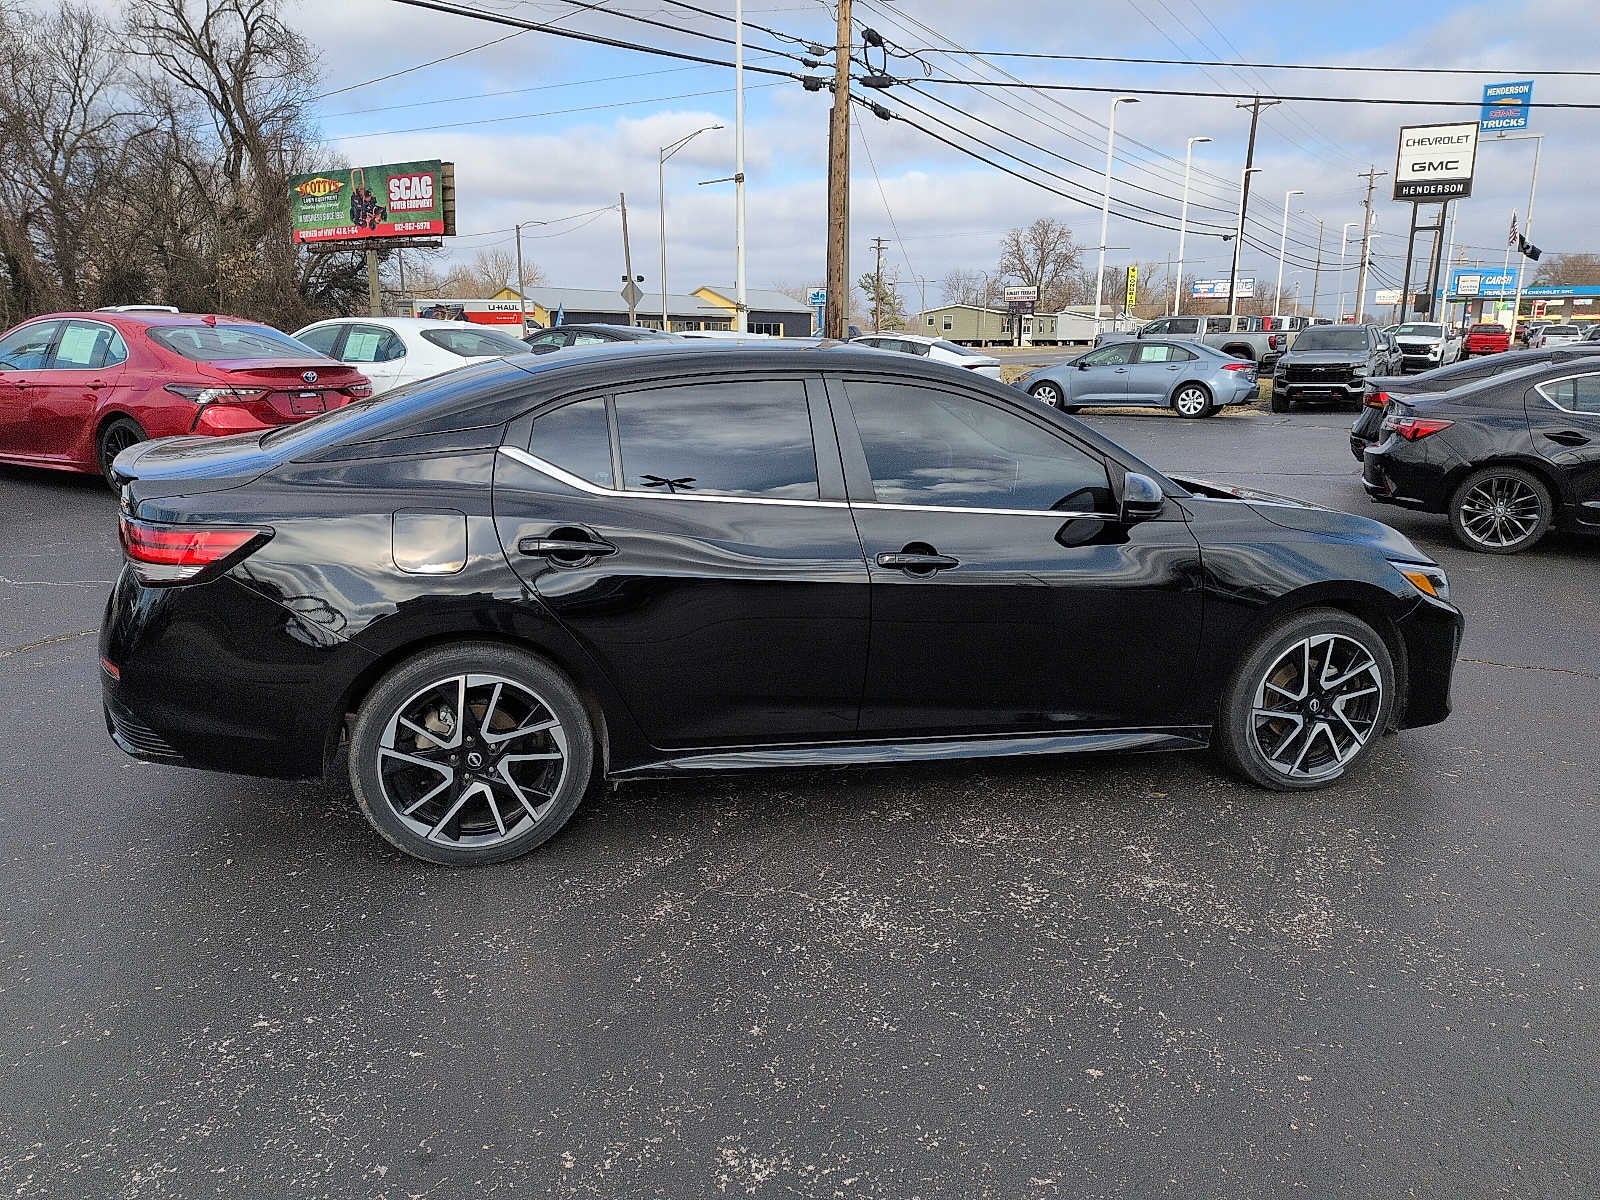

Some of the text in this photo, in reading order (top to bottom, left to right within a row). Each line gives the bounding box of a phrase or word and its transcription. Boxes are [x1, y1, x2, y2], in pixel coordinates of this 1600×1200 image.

[1487, 85, 1529, 96] HENDERSON
[1482, 117, 1525, 129] TRUCKS
[1405, 135, 1471, 147] CHEVROLET
[1411, 160, 1459, 172] GMC
[389, 176, 433, 200] SCAG
[1402, 184, 1464, 195] HENDERSON
[390, 199, 433, 210] POWER EQUIPMENT
[299, 230, 317, 238] CORNER
[324, 228, 336, 236] HWY
